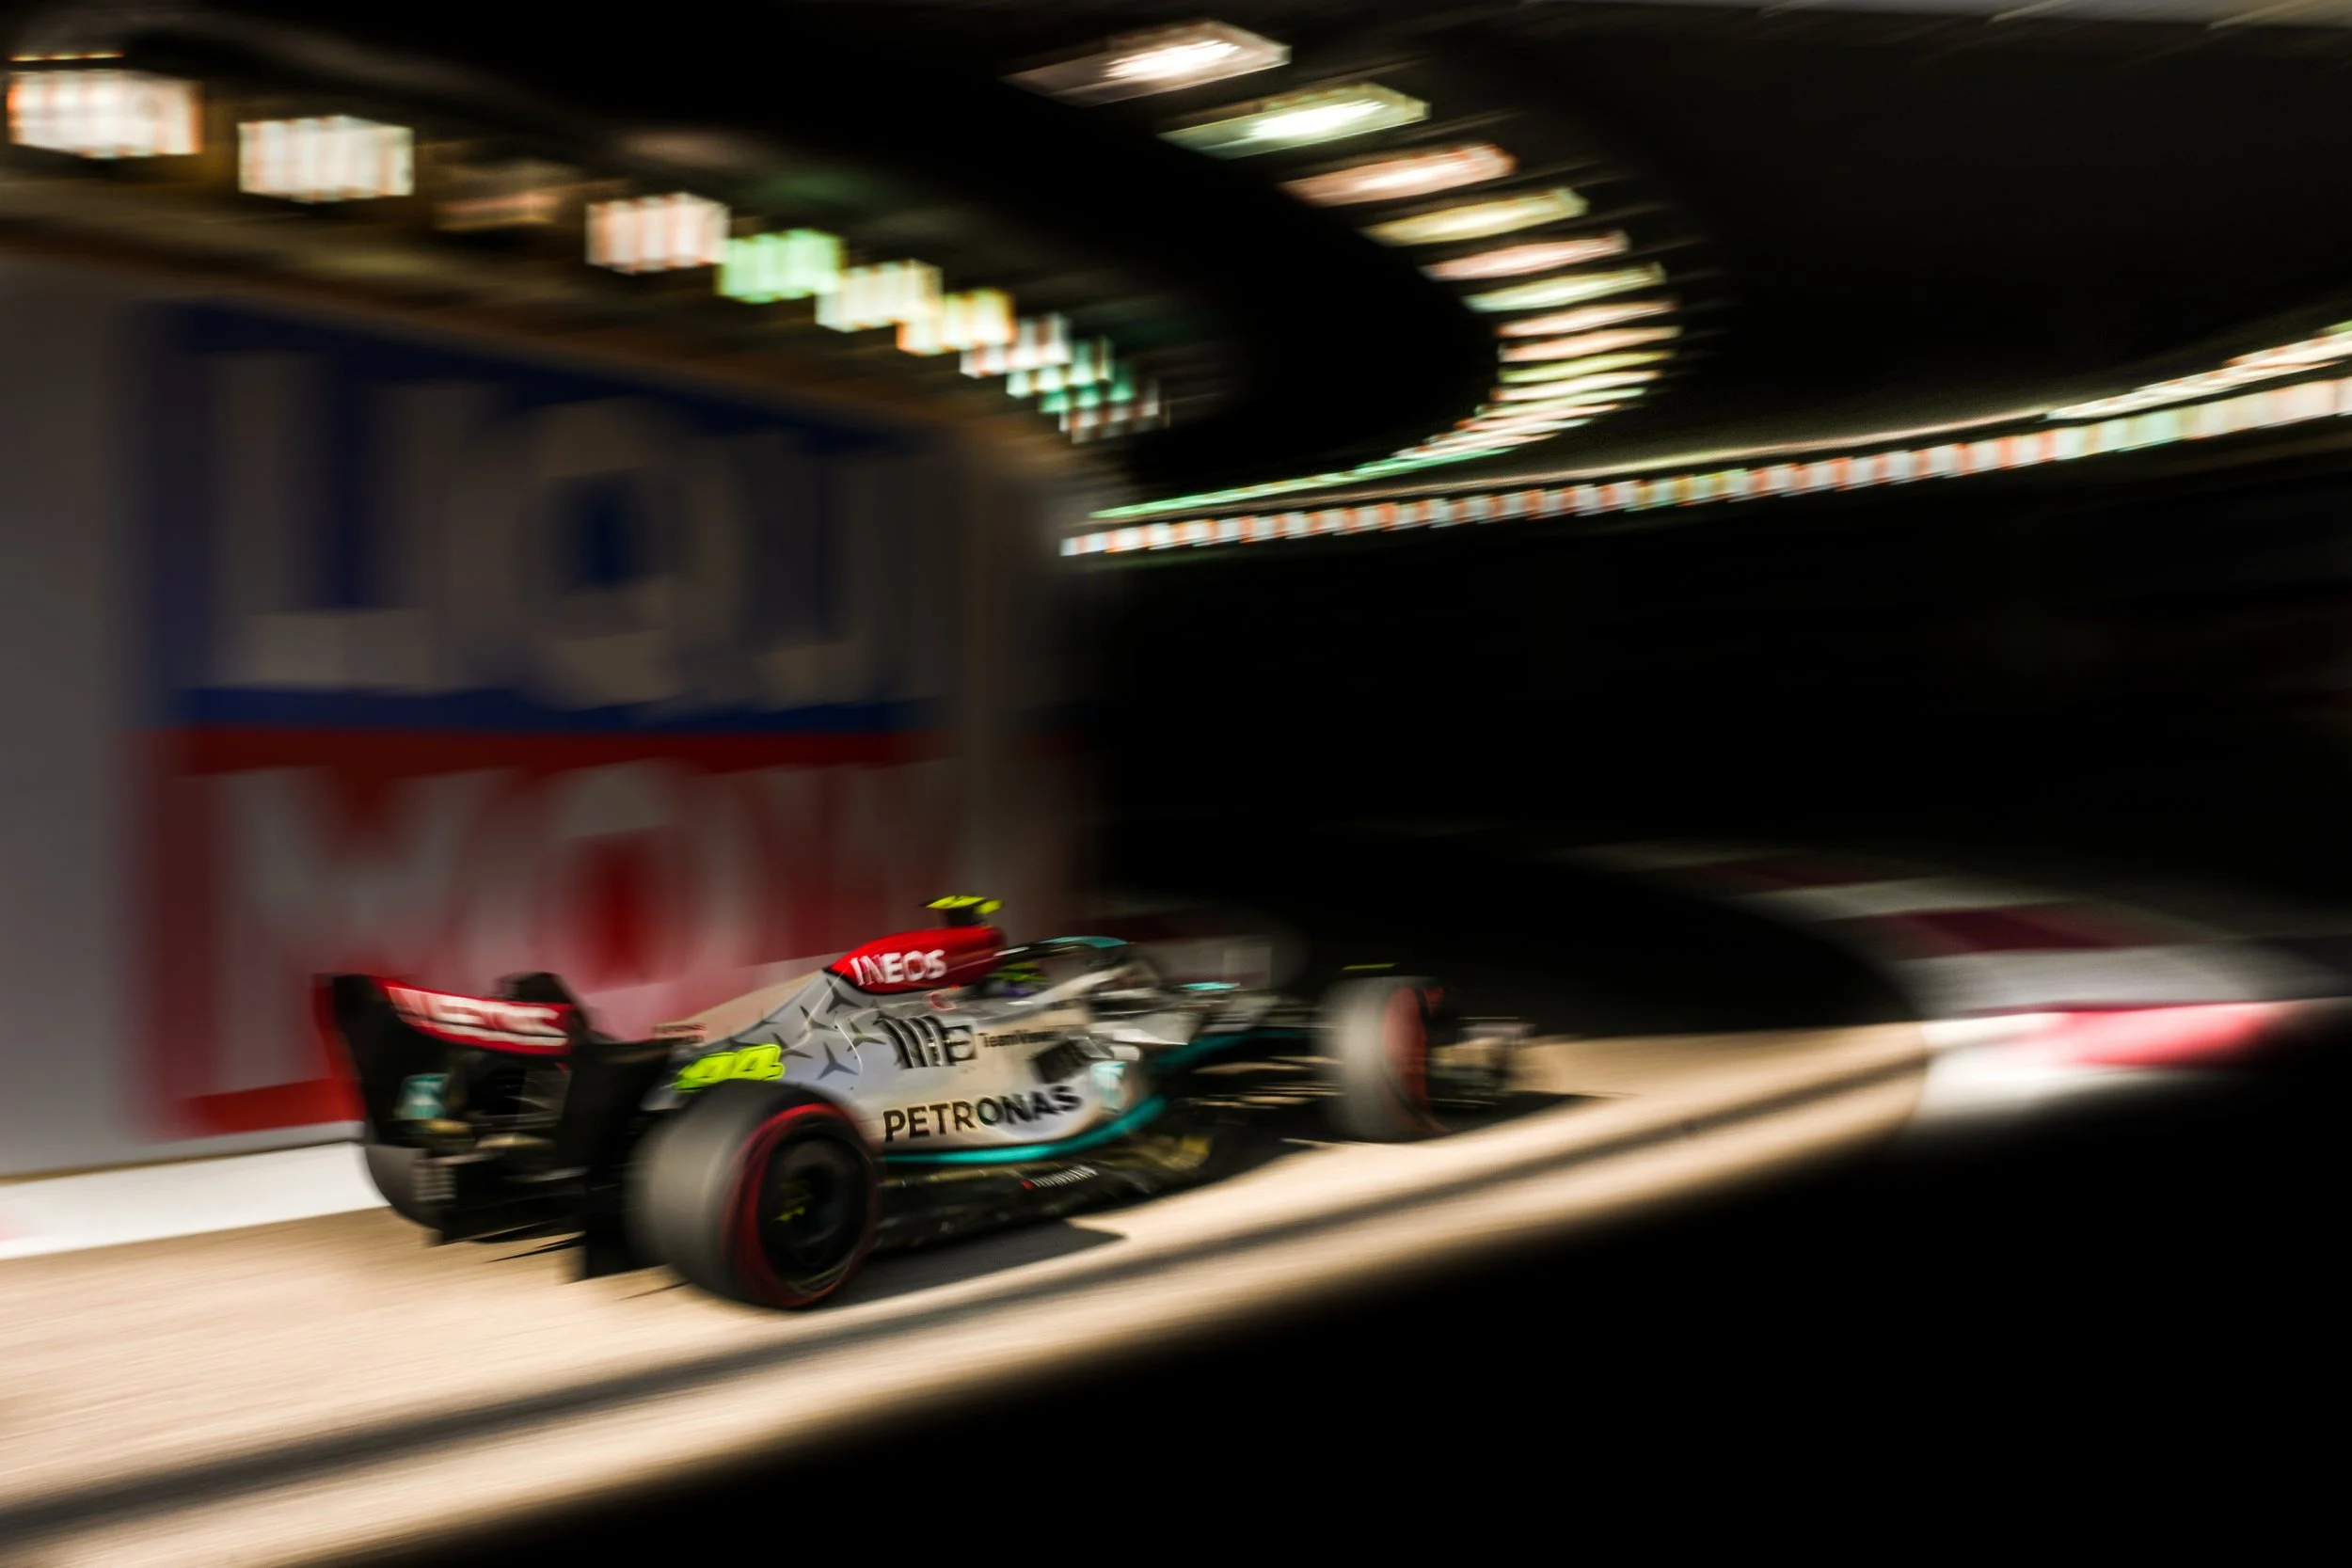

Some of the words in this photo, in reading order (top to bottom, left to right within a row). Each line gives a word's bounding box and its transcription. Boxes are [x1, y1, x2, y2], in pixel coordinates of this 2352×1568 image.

[196, 346, 927, 712] LIQU
[850, 949, 946, 986] INEOS
[882, 1085, 1083, 1144] PETRONAS
